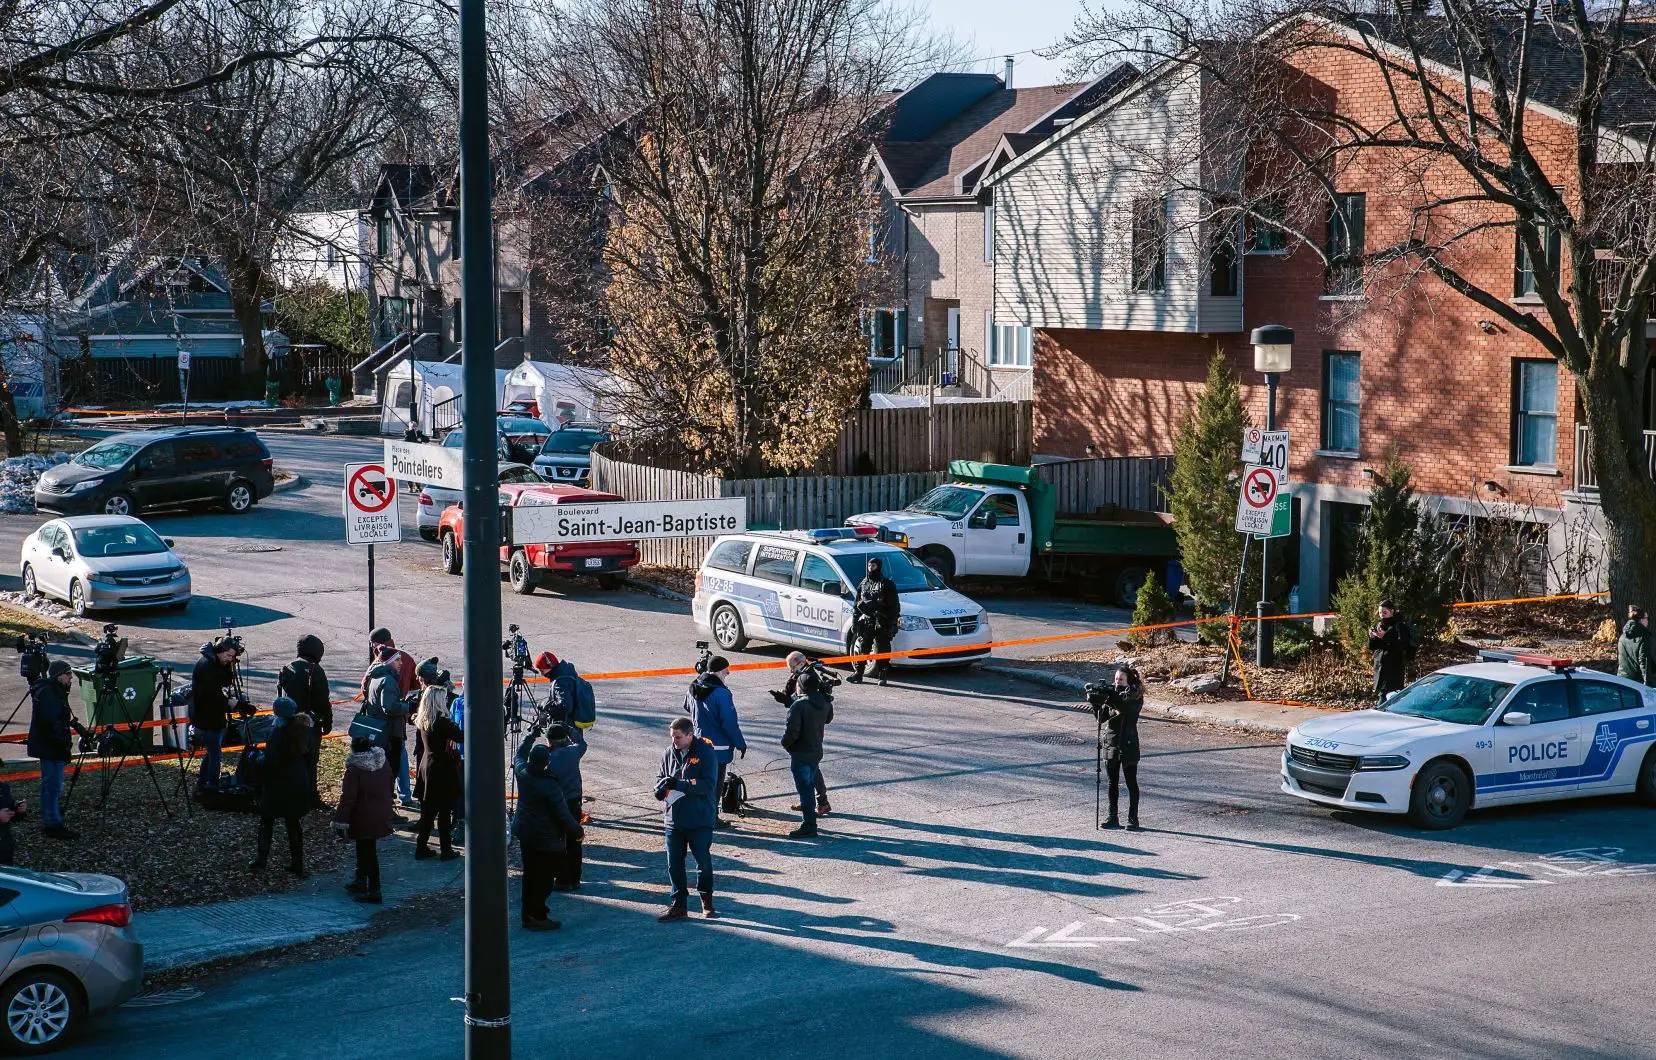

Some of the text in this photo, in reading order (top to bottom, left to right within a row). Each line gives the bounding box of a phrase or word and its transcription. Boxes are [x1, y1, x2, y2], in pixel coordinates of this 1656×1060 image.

[1264, 444, 1286, 470] 40
[392, 455, 443, 480] Pointeliers
[557, 507, 599, 516] Boulevard
[354, 522, 393, 532] LIVRAISON
[557, 512, 737, 538] Saint-Jean-Baptiste
[951, 521, 964, 530] 219
[709, 577, 734, 593] 92-85
[796, 604, 834, 623] POLICE
[1475, 740, 1493, 749] 49-3
[1508, 741, 1568, 764] POLICE
